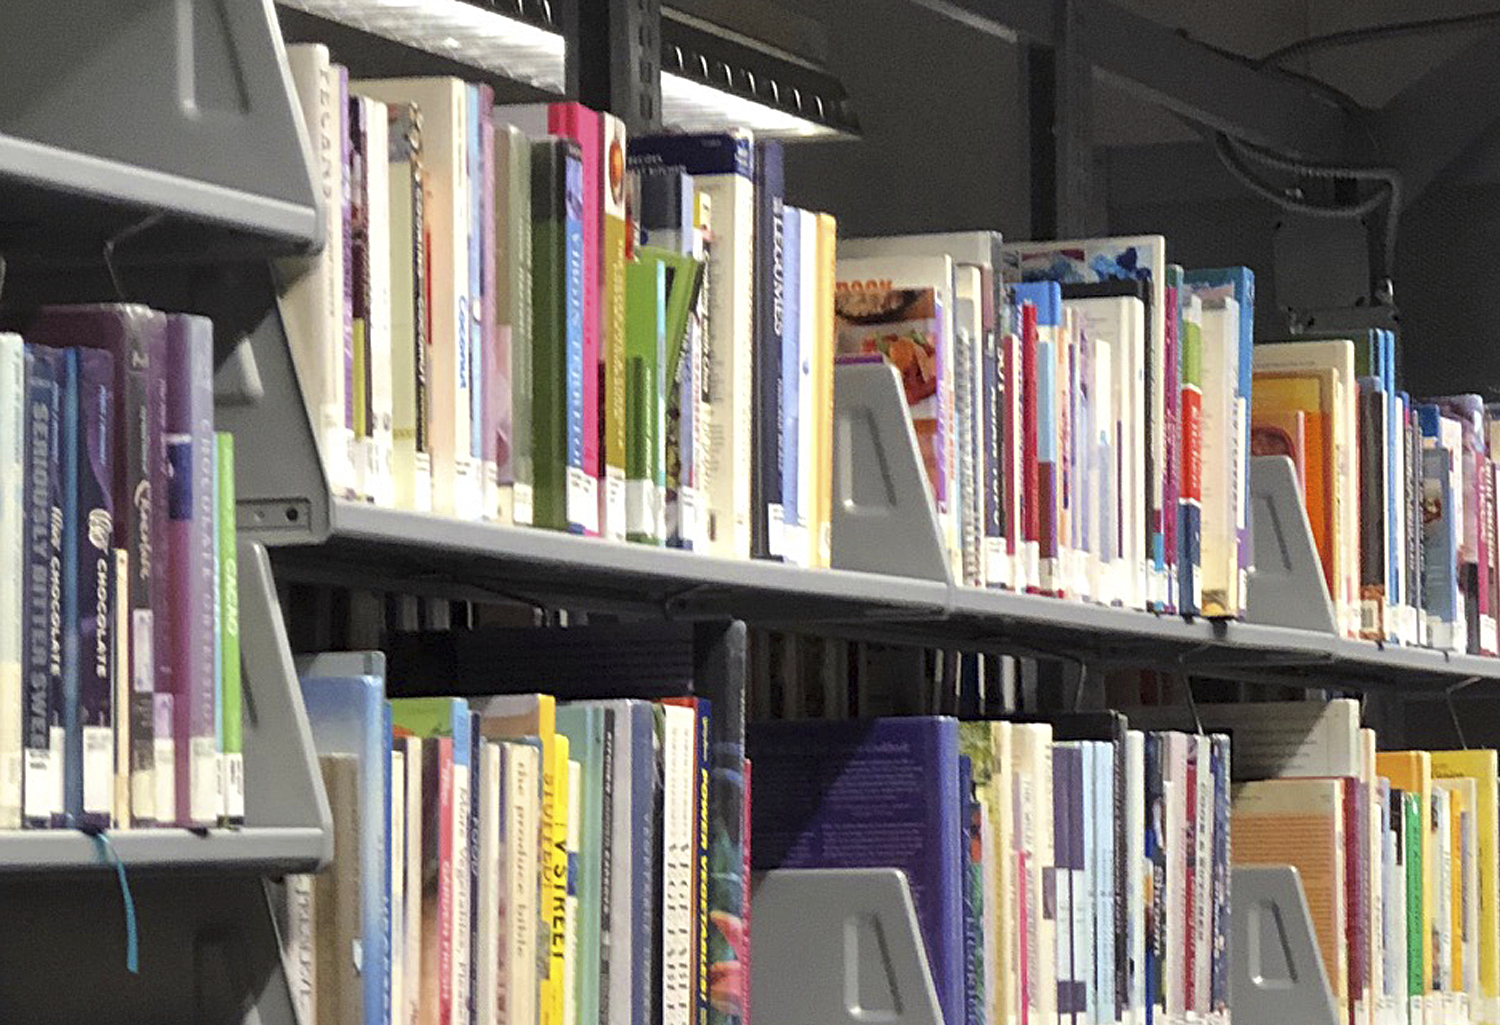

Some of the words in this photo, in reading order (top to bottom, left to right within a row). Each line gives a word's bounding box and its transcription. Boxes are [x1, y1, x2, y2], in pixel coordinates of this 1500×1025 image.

[458, 295, 469, 389] Coconut
[31, 401, 50, 557] SERIOUSLY
[30, 564, 49, 668] BITTER
[50, 555, 62, 677] CHOCOLATE
[96, 558, 109, 678] CHOCOLATE
[225, 557, 239, 637] CACAO
[29, 671, 48, 748] SWEE
[515, 805, 526, 897] produce
[700, 768, 709, 850] POWER
